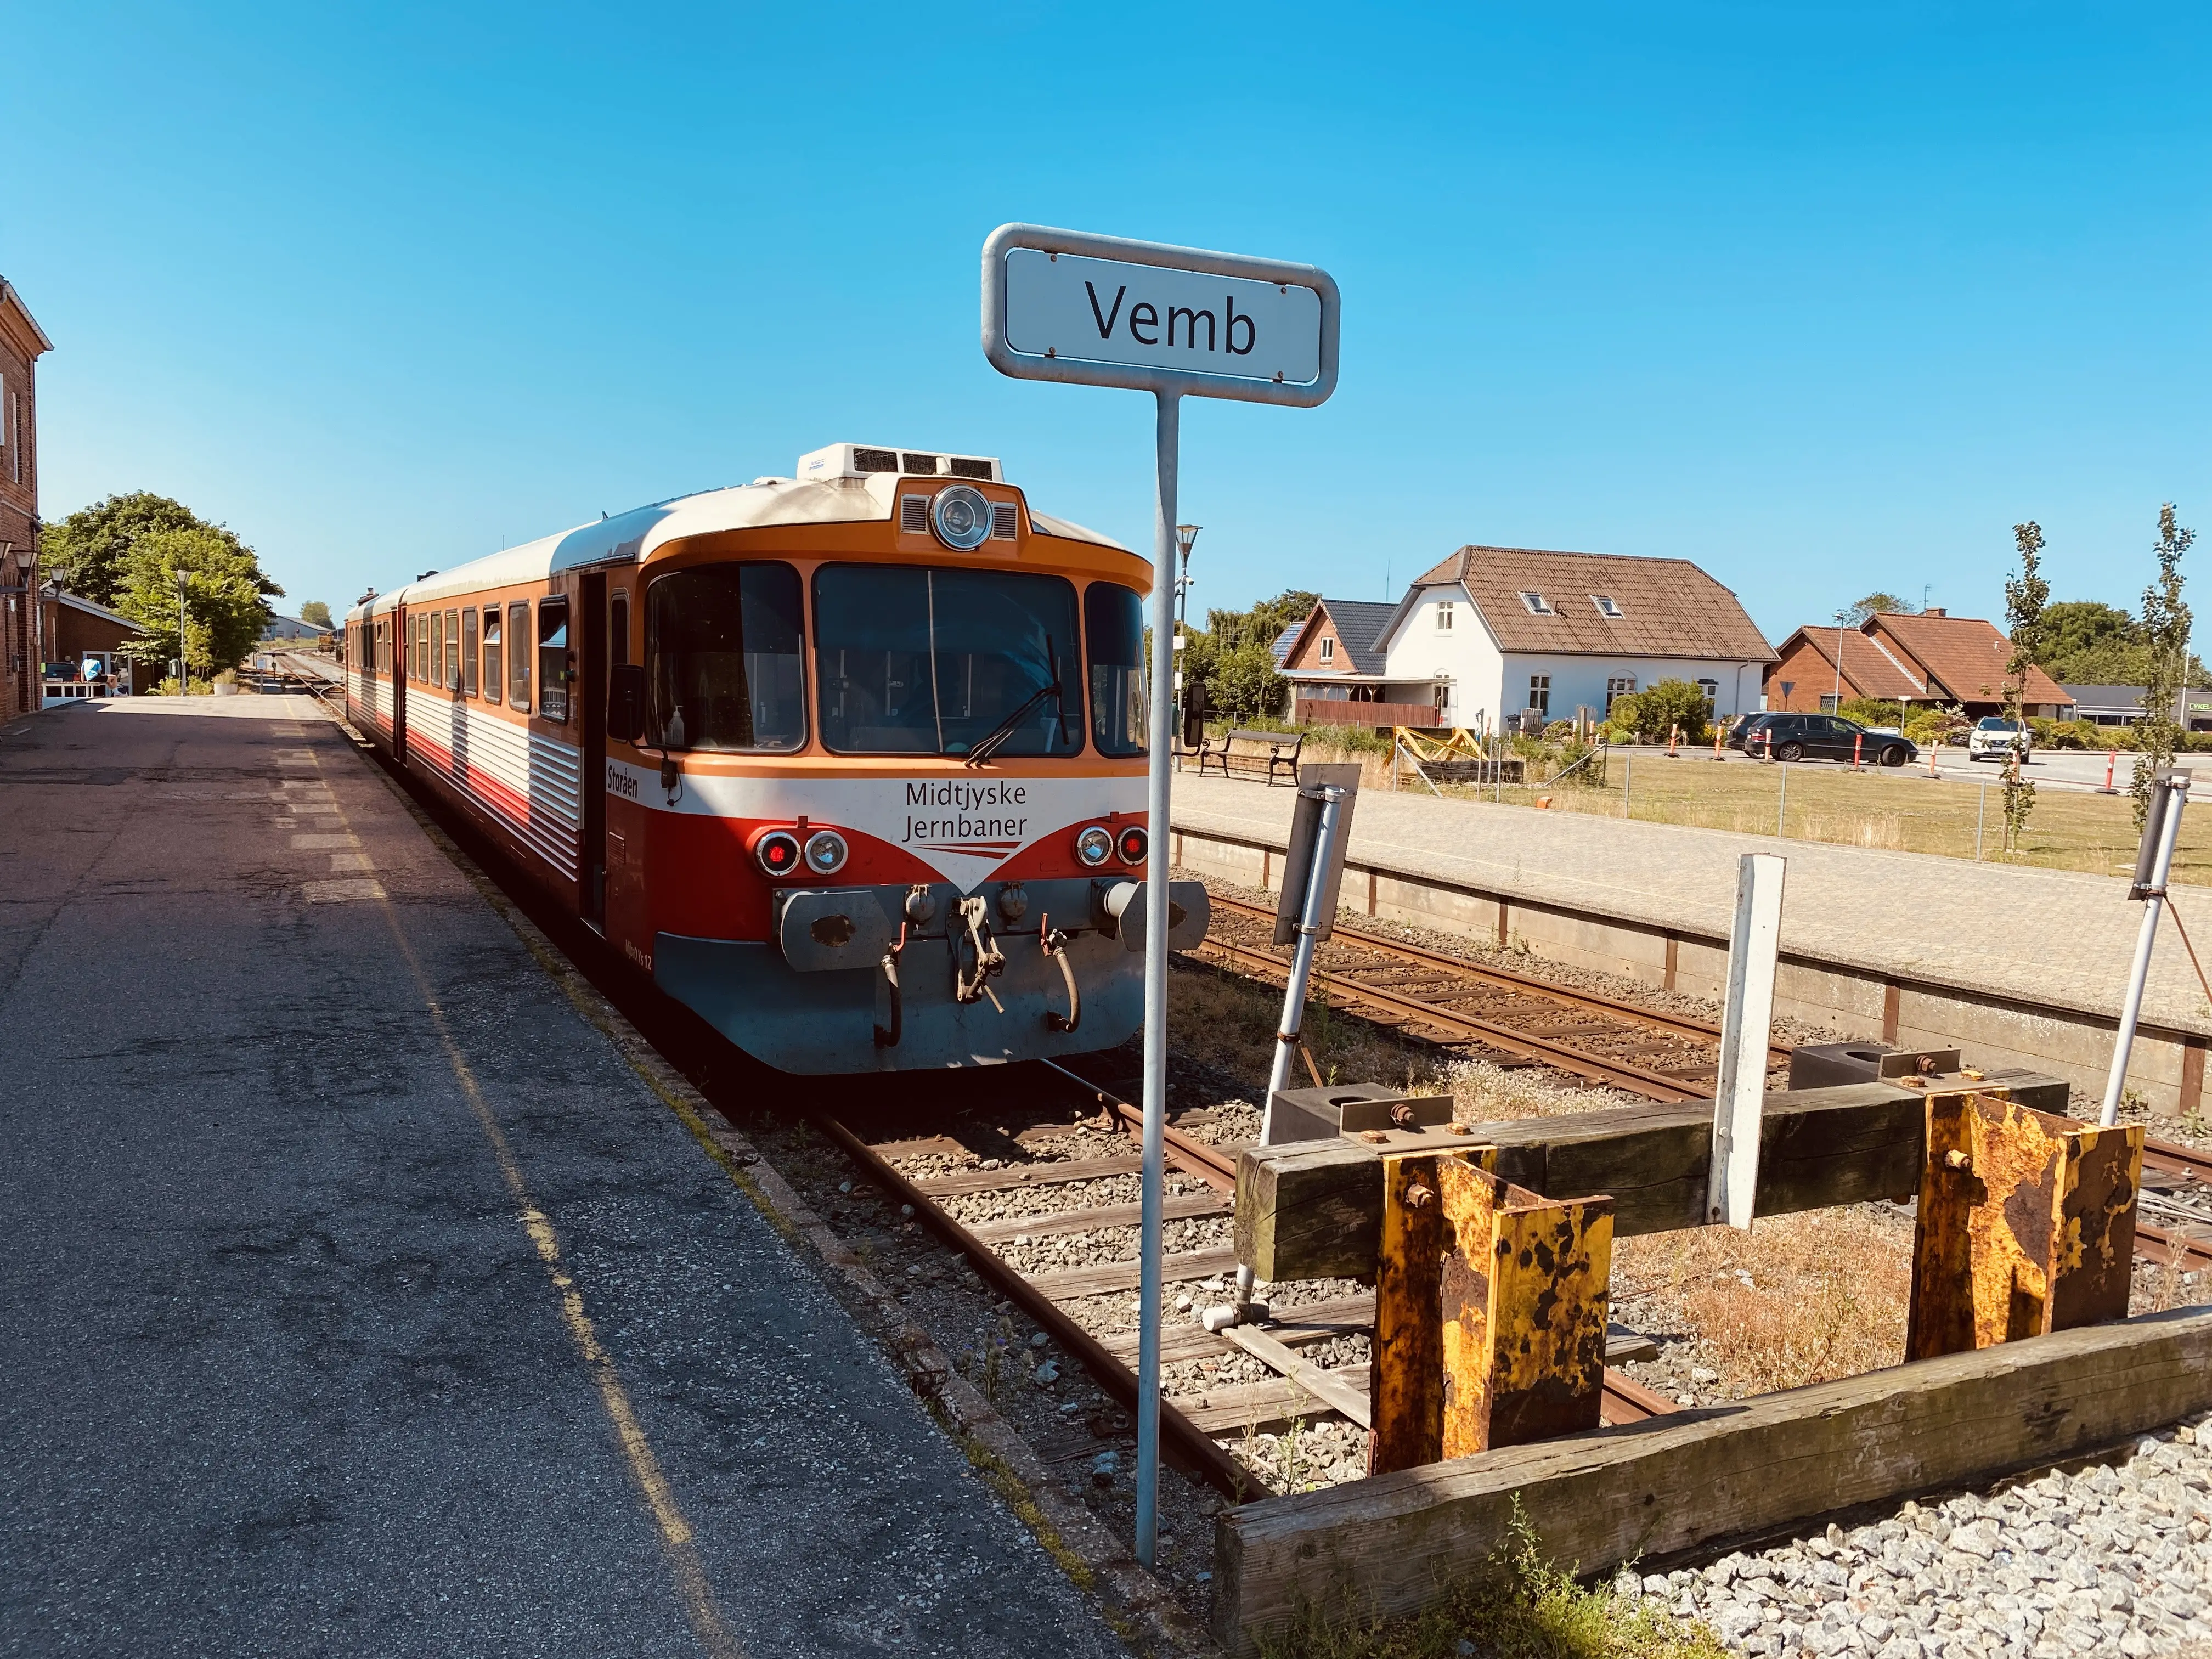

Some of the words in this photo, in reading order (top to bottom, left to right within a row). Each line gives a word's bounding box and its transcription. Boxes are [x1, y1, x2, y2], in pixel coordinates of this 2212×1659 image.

[1084, 281, 1256, 356] Vemb
[607, 765, 638, 799] Storåen
[906, 781, 1027, 810] Midtjyske
[902, 814, 1028, 843] Jernbaner
[644, 954, 652, 970] 12
